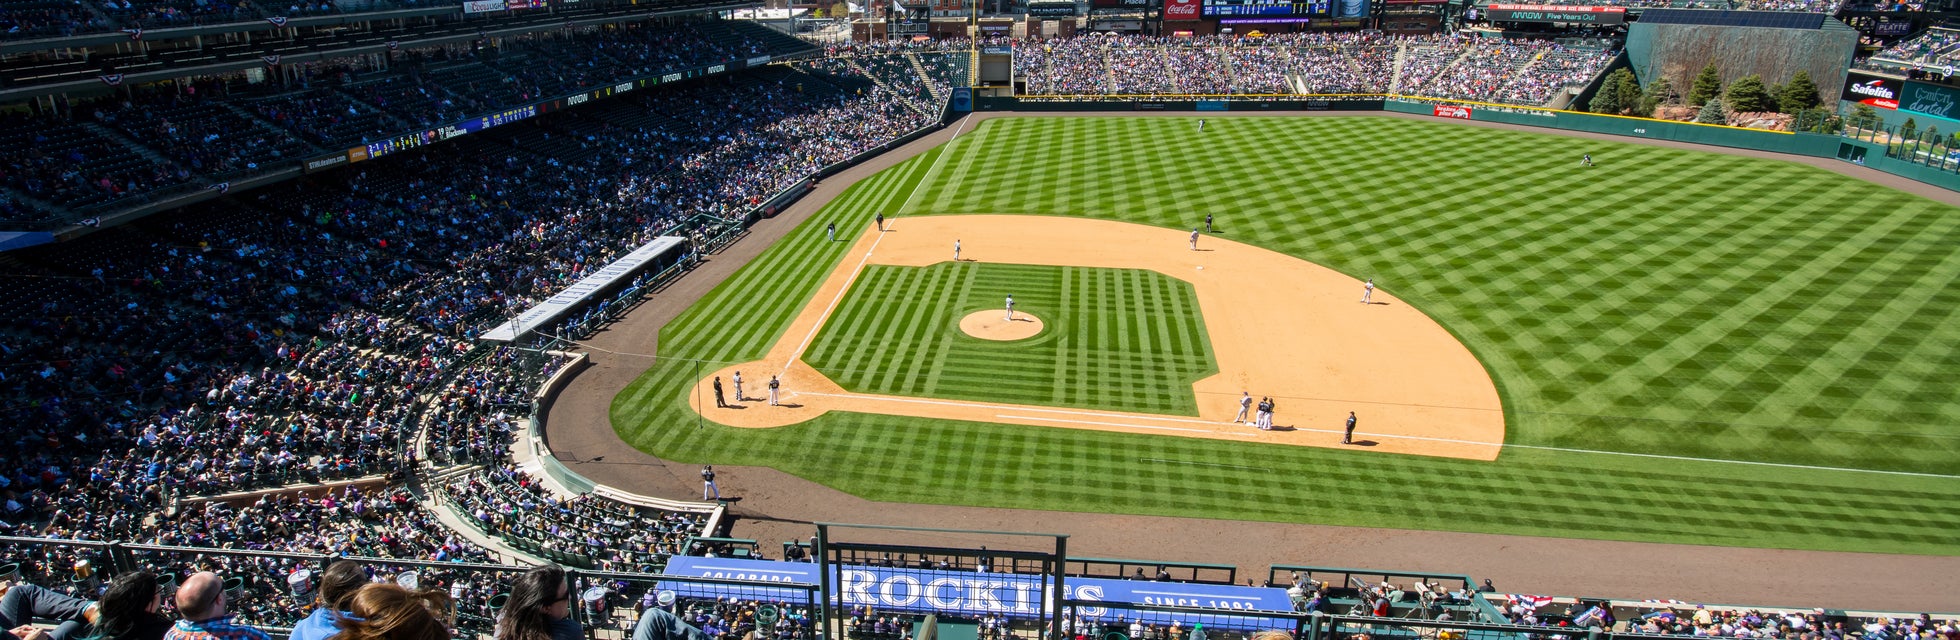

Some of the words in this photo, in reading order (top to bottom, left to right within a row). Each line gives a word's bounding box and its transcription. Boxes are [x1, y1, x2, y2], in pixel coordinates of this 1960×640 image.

[471, 2, 489, 12] Coors
[490, 2, 504, 10] LIGHT
[1167, 4, 1197, 15] Coca-Cola
[708, 64, 725, 74] ARROW
[662, 72, 682, 83] ARROW
[615, 82, 633, 93] ARROW
[1850, 83, 1894, 99] Safelite
[567, 93, 589, 106] ARROW
[1915, 87, 1952, 103] Comfort
[1908, 98, 1954, 117] dental
[830, 570, 1109, 617] ROCKIES
[1144, 596, 1198, 608] SINCE
